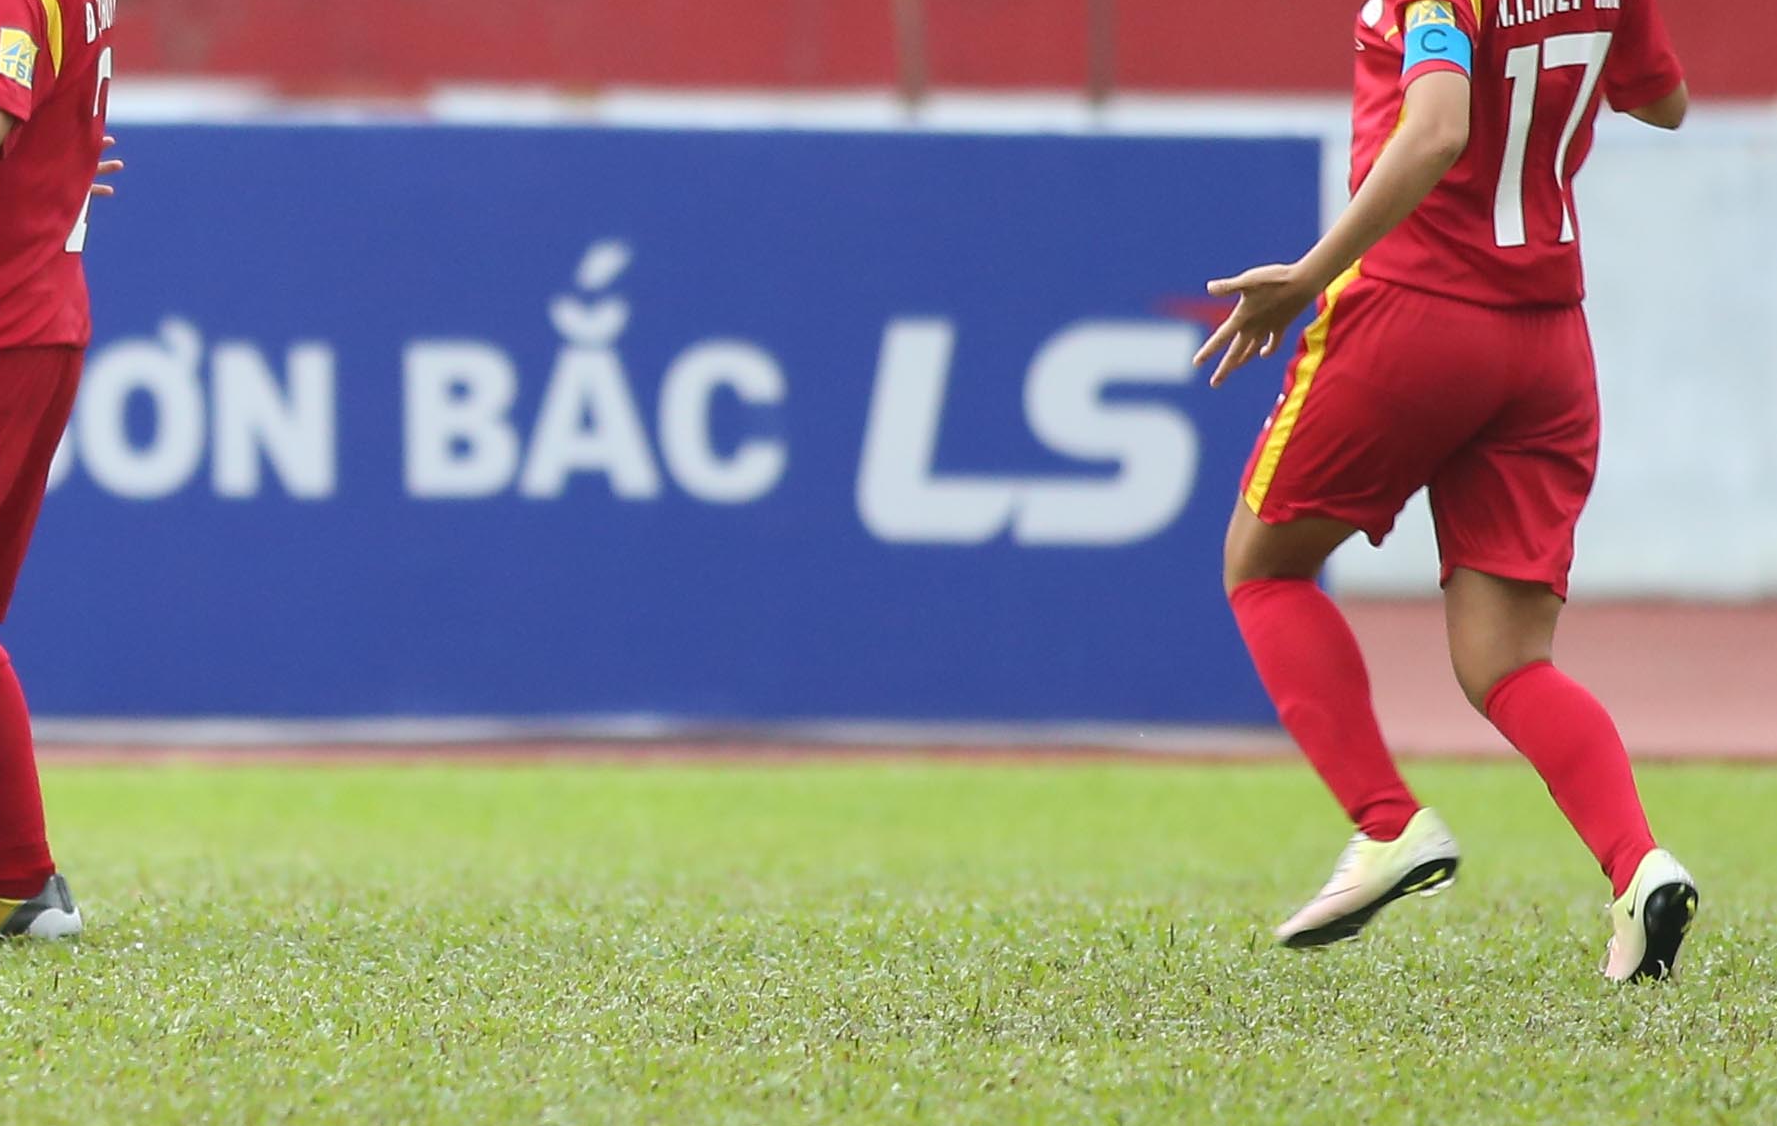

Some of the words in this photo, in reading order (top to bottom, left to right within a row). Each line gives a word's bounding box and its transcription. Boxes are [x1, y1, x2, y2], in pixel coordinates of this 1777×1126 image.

[1419, 28, 1449, 54] C
[1493, 31, 1613, 247] 17
[46, 317, 337, 501] ƠN
[405, 240, 788, 504] BẮC
[855, 317, 1204, 550] LS
